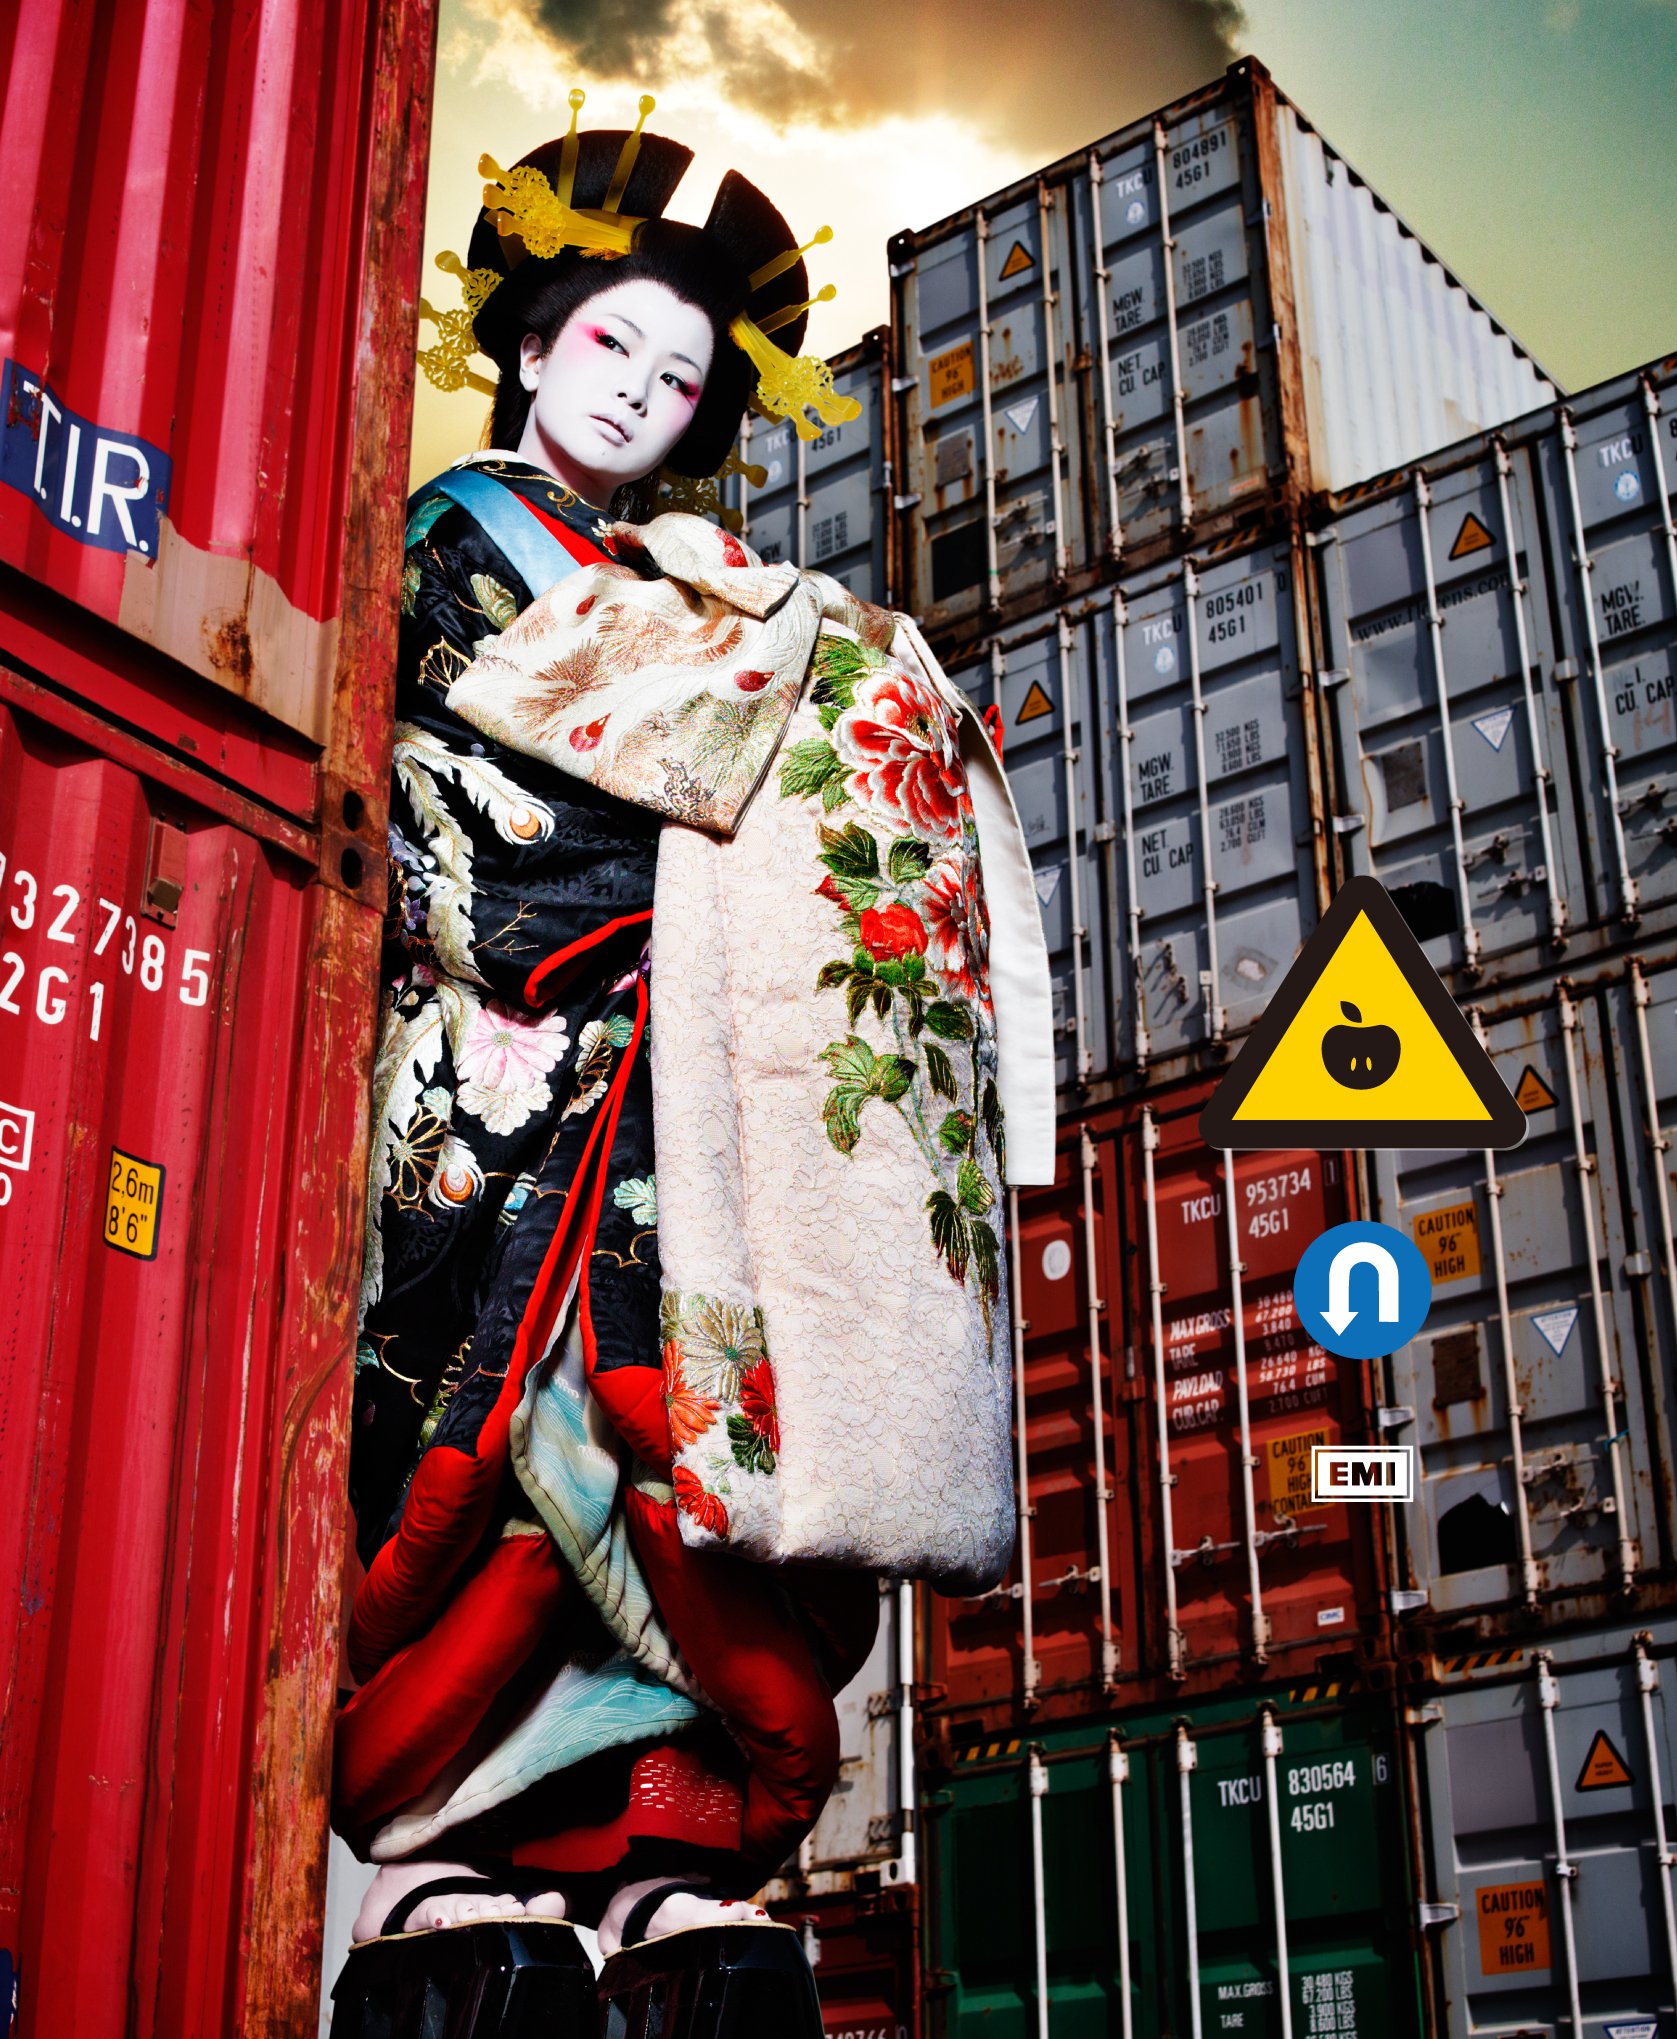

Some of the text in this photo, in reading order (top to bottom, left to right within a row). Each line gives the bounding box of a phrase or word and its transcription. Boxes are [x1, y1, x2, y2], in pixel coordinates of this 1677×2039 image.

[1116, 167, 1153, 198] TKCU
[1173, 130, 1226, 169] 804891
[1599, 433, 1644, 467] TKCU
[23, 380, 150, 552] T.I.R.
[1142, 613, 1183, 645] TKCU
[1207, 582, 1264, 619] 805401
[1208, 615, 1246, 644] 45G1
[1181, 1194, 1222, 1225] TKCU
[1246, 1168, 1312, 1207] 953734
[1248, 1208, 1289, 1239] 45G1
[1418, 1207, 1474, 1237] CAUTION
[1434, 1255, 1465, 1278] HIGH
[1306, 1357, 1327, 1372] LBS
[1172, 1371, 1224, 1402] PAYLOAD
[1272, 1431, 1325, 1459] CAUTION
[1217, 1775, 1262, 1807] TKCU
[1288, 1760, 1356, 1795] 830564
[1290, 1802, 1335, 1832] 45G1
[1481, 1887, 1545, 1914] CAUTION
[1499, 1943, 1535, 1966] HIGH
[1334, 1971, 1354, 1986] KGS
[1335, 1985, 1354, 2001] LBS
[1220, 2013, 1244, 2029] TARE
[1336, 2000, 1356, 2016] KGS
[1338, 2014, 1356, 2030] LBS
